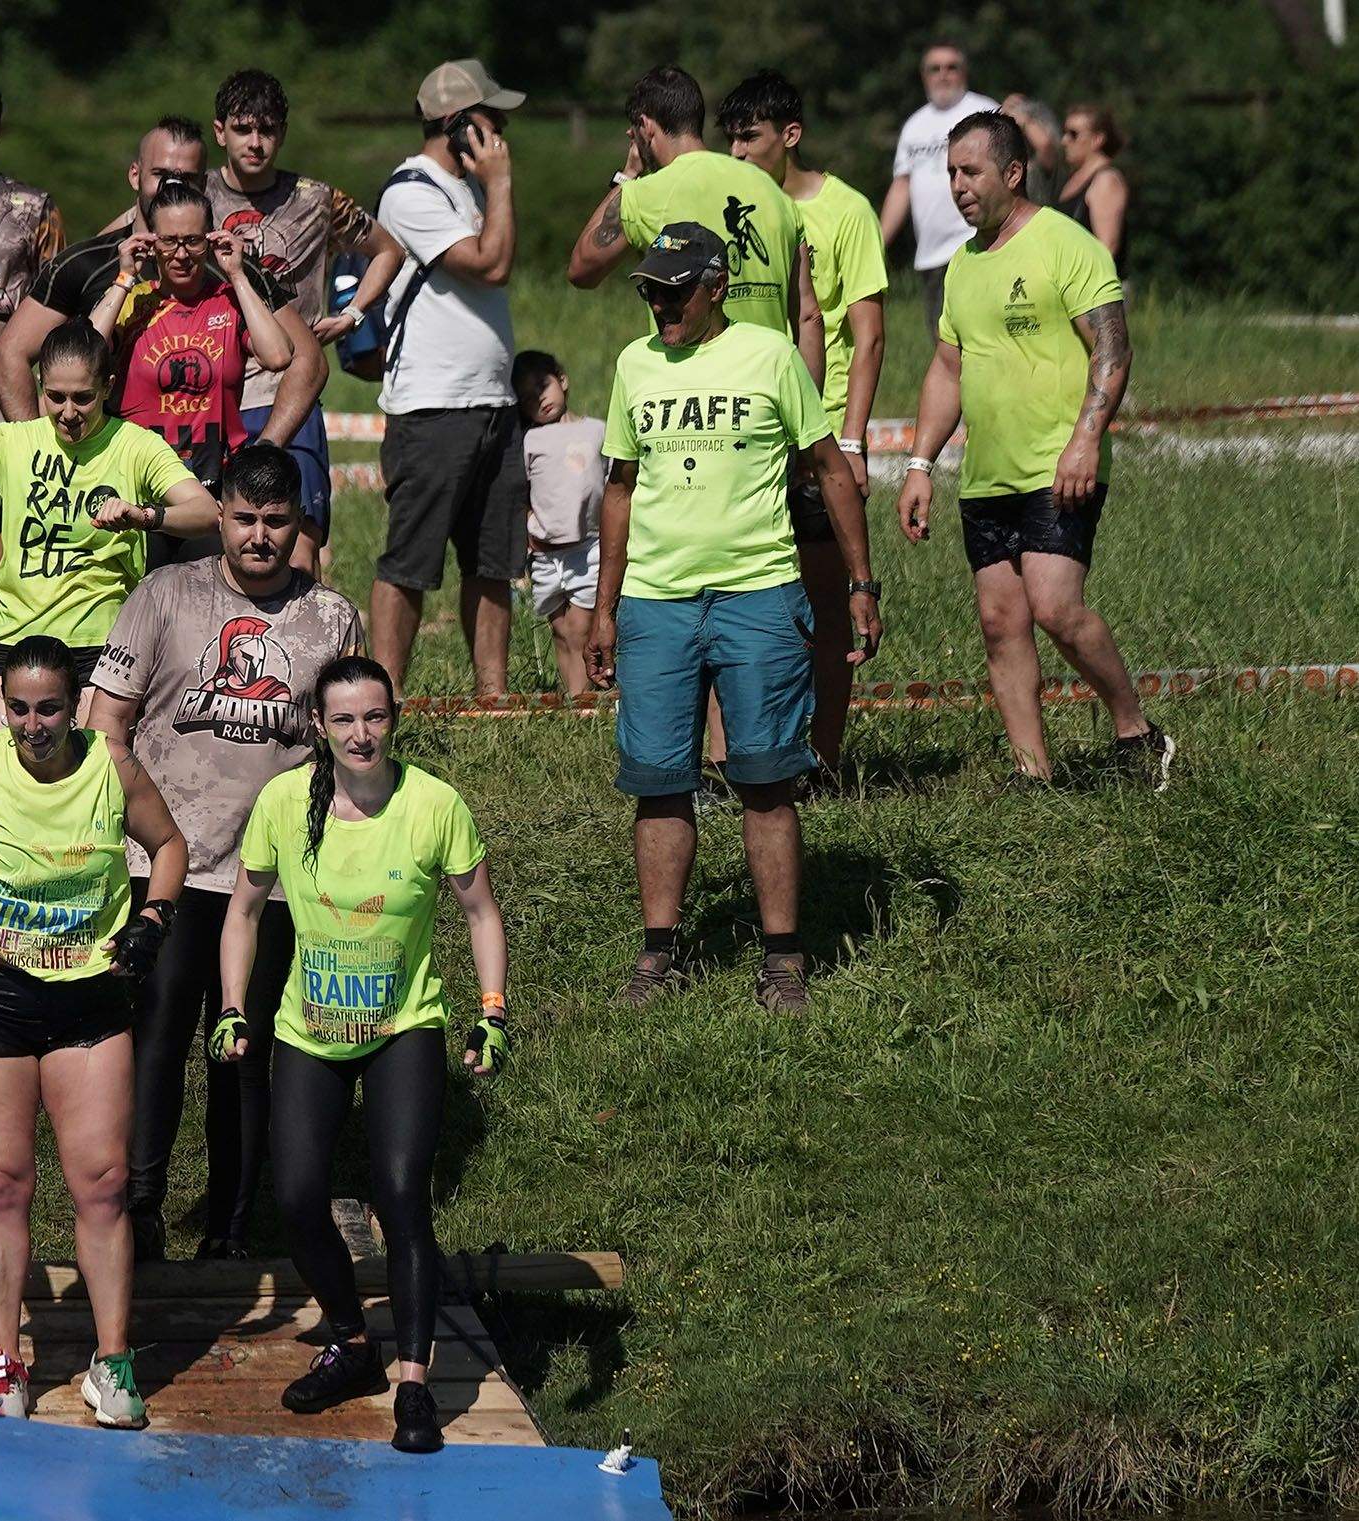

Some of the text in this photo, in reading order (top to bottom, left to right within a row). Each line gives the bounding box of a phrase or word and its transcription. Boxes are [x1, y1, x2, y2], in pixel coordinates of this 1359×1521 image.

[143, 331, 224, 368] LLANERA
[158, 393, 212, 416] Race
[639, 396, 751, 434] STAFF
[656, 440, 725, 454] GLADIATORRACE
[31, 449, 79, 488] UN
[19, 516, 73, 555] DE
[19, 549, 95, 579] LUZ
[98, 660, 131, 681] WIRE
[221, 723, 261, 743] RACE
[388, 870, 403, 880] MEL
[328, 939, 363, 952] ACTIVITY
[6, 948, 73, 969] MUSCLE LIFE
[302, 948, 337, 972] ALTH
[304, 970, 398, 1008] RAINER
[335, 1010, 368, 1022] ATHLETE
[312, 1022, 378, 1045] MUSCLE LIFE
